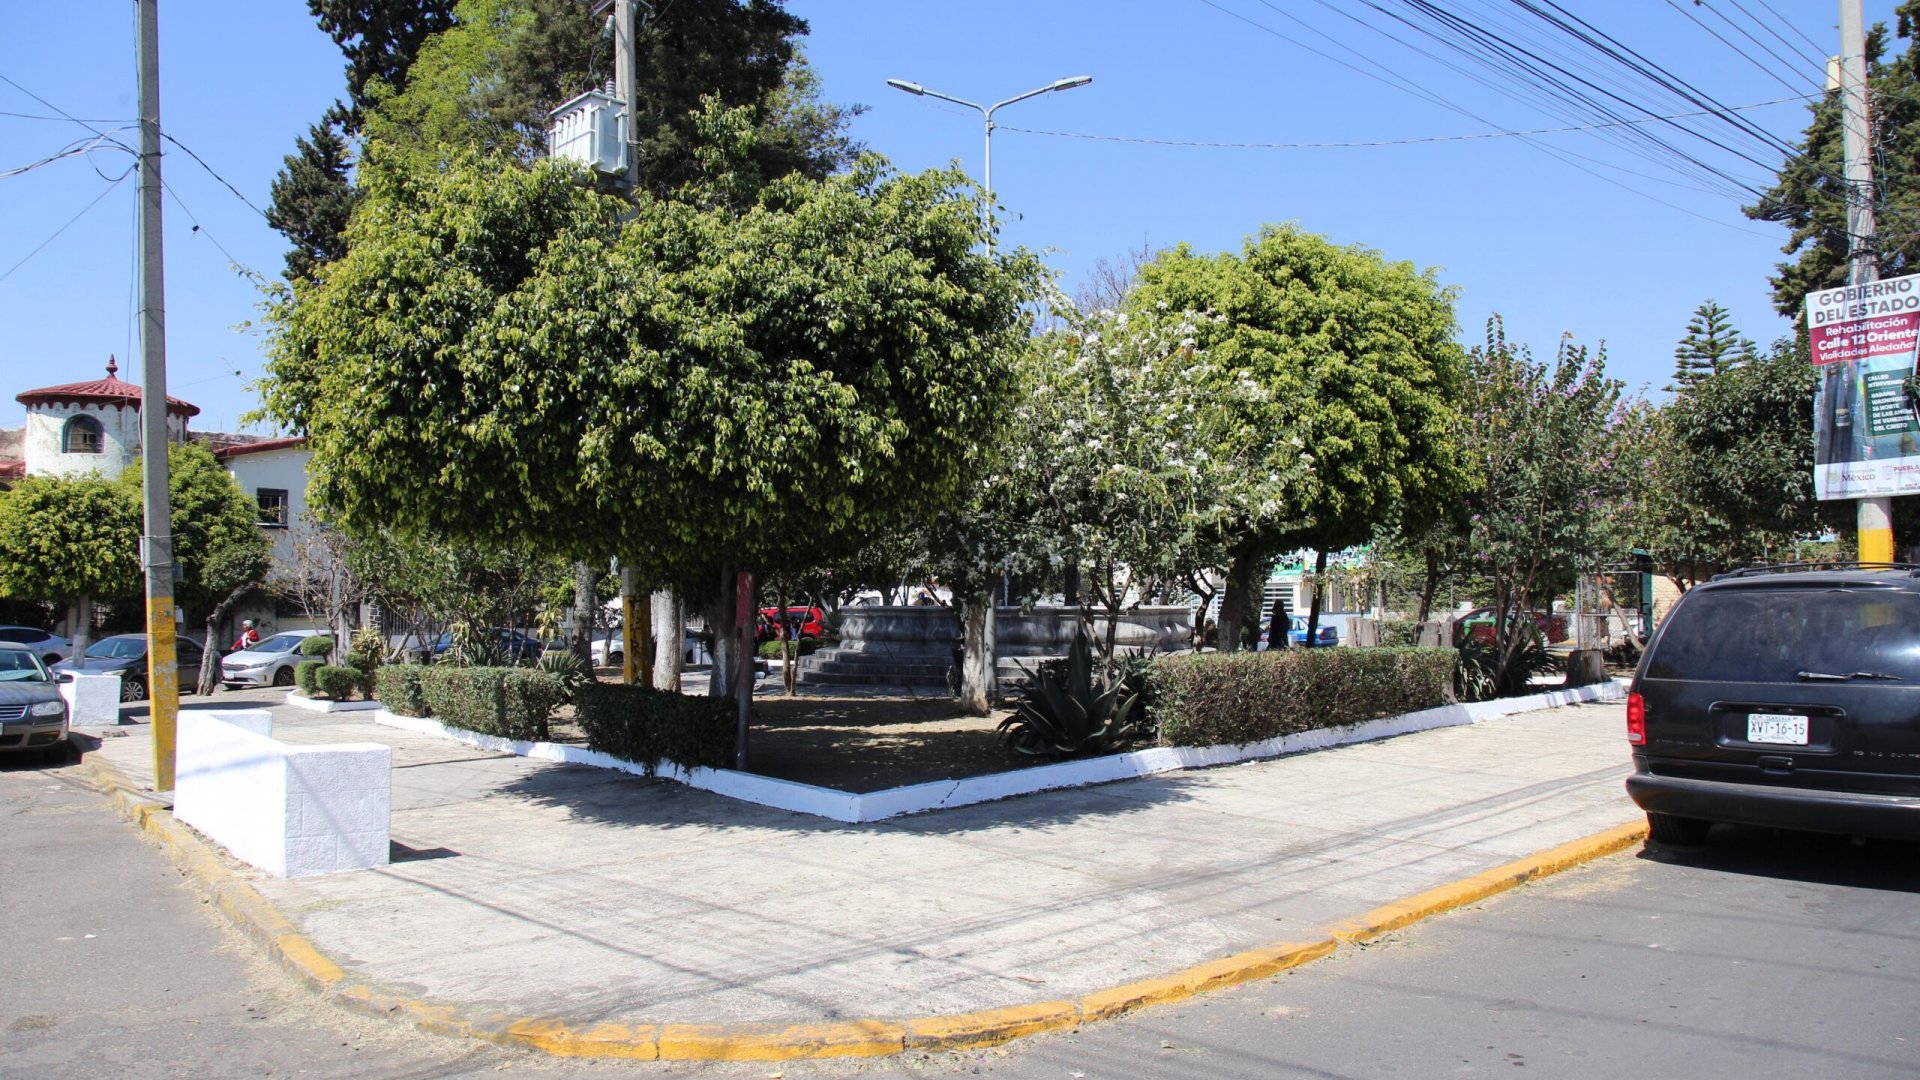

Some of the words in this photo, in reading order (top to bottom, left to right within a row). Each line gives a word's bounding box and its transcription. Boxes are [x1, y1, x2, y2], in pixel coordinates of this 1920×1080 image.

[1819, 279, 1912, 306] GOBIERNO
[1815, 307, 1844, 323] DEL
[1848, 295, 1920, 318] ESTADO
[1826, 317, 1908, 336] Rehabilitación
[1818, 336, 1849, 350] Calle
[1852, 333, 1866, 345] 12
[1866, 328, 1918, 343] Oriente
[1819, 347, 1868, 361] Vialidades
[1841, 472, 1876, 482] México
[1750, 720, 1805, 736] XVT-16-15
